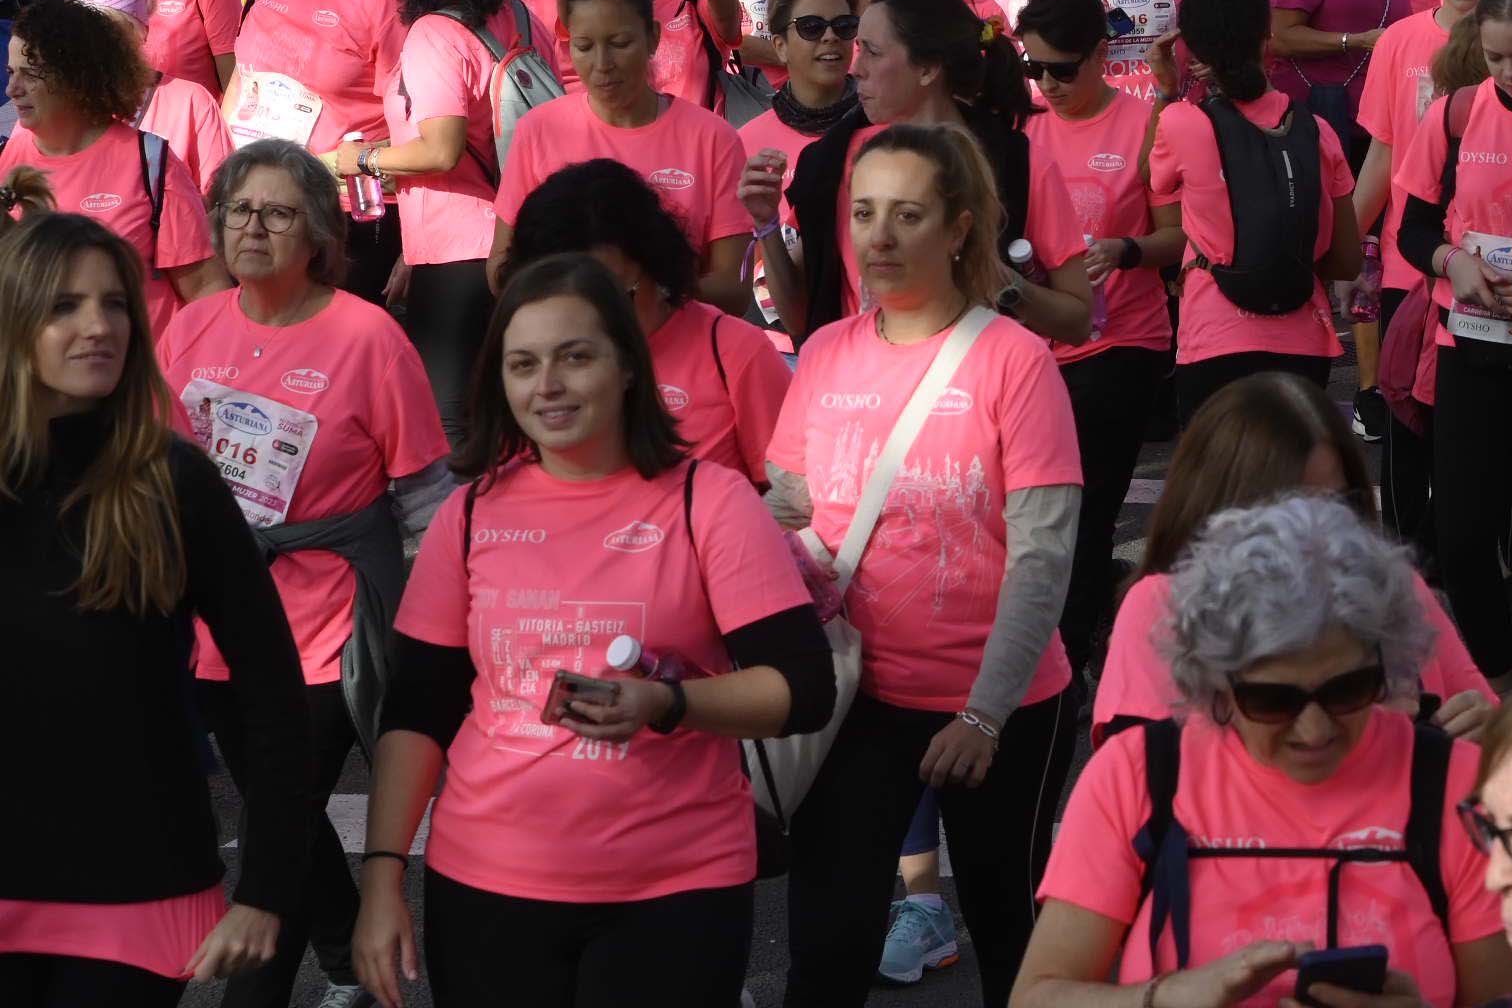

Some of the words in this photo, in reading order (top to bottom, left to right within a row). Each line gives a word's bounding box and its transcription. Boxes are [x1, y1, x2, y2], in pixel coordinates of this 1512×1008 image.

[1090, 160, 1124, 168] ASTURIANA
[1460, 151, 1508, 165] OYSHO
[652, 174, 692, 185] ASTURIANA
[1458, 320, 1491, 333] OYSHO
[191, 366, 240, 380] OYSHO
[284, 375, 326, 390] ASTURIANA
[820, 392, 881, 409] OYSHO
[222, 407, 269, 433] ASTURIANA
[215, 437, 258, 466] 016
[474, 528, 547, 545] OYSHO
[518, 619, 564, 633] VITORIA
[575, 619, 626, 634] GASTEIZ
[542, 633, 592, 646] MADRID
[518, 659, 532, 670] VA
